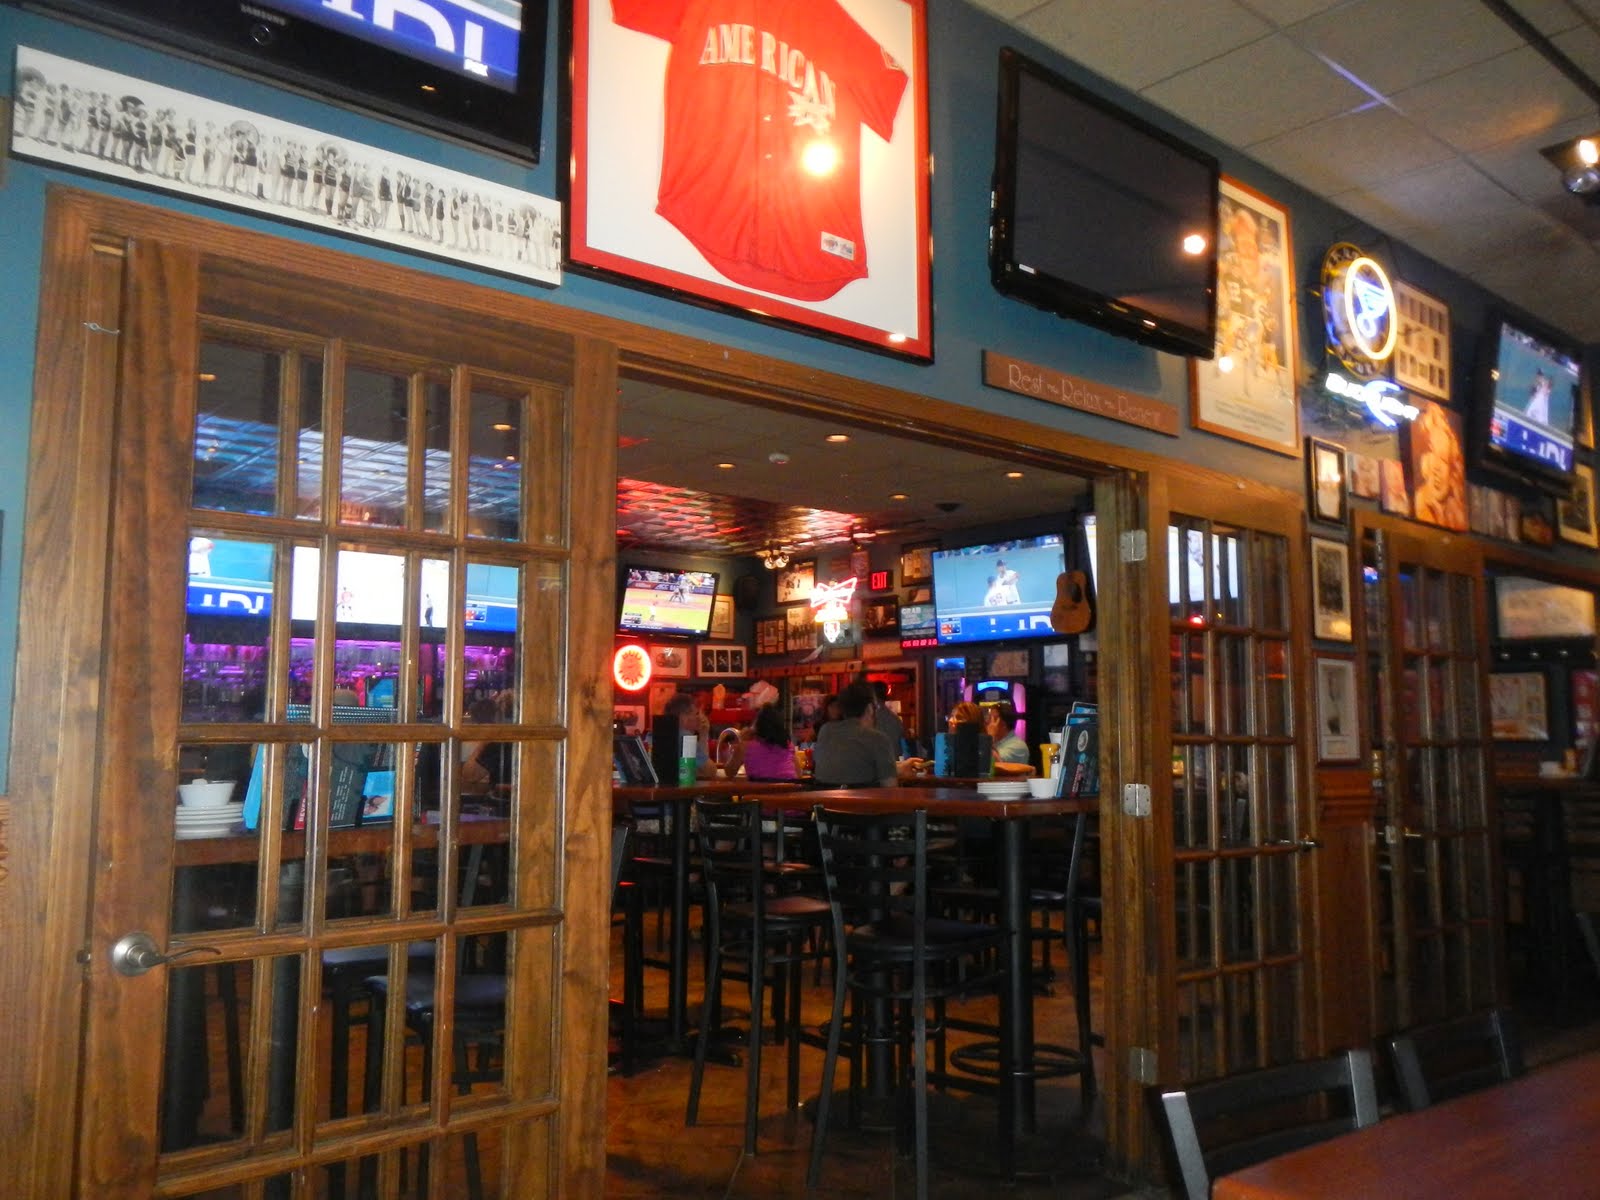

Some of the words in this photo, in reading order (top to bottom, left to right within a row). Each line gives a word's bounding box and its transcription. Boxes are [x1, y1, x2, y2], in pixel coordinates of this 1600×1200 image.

[698, 23, 837, 121] AMERICAN
[1008, 364, 1044, 394] Rest
[871, 571, 888, 590] EXIT
